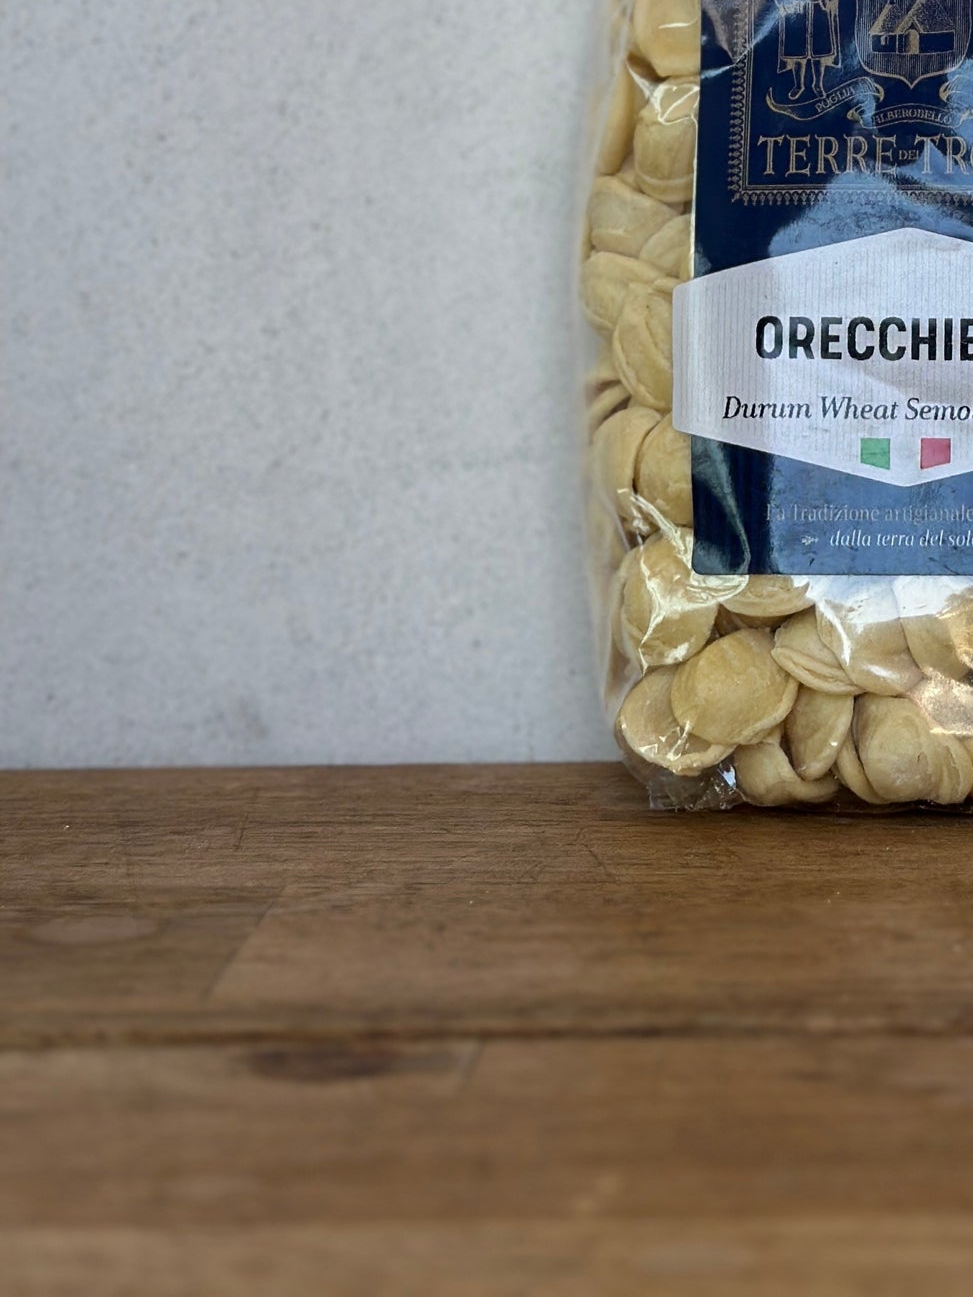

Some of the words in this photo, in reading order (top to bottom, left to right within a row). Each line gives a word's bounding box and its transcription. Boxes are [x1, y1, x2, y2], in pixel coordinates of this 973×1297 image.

[872, 108, 951, 124] ALBEROBELLO
[757, 134, 897, 177] TERRE
[899, 149, 919, 161] DEI
[722, 395, 812, 420] Durum
[820, 396, 899, 421] Wheat
[792, 503, 879, 522] Tradizione
[829, 529, 871, 547] dalla
[876, 533, 914, 547] terra
[919, 529, 944, 547] del
